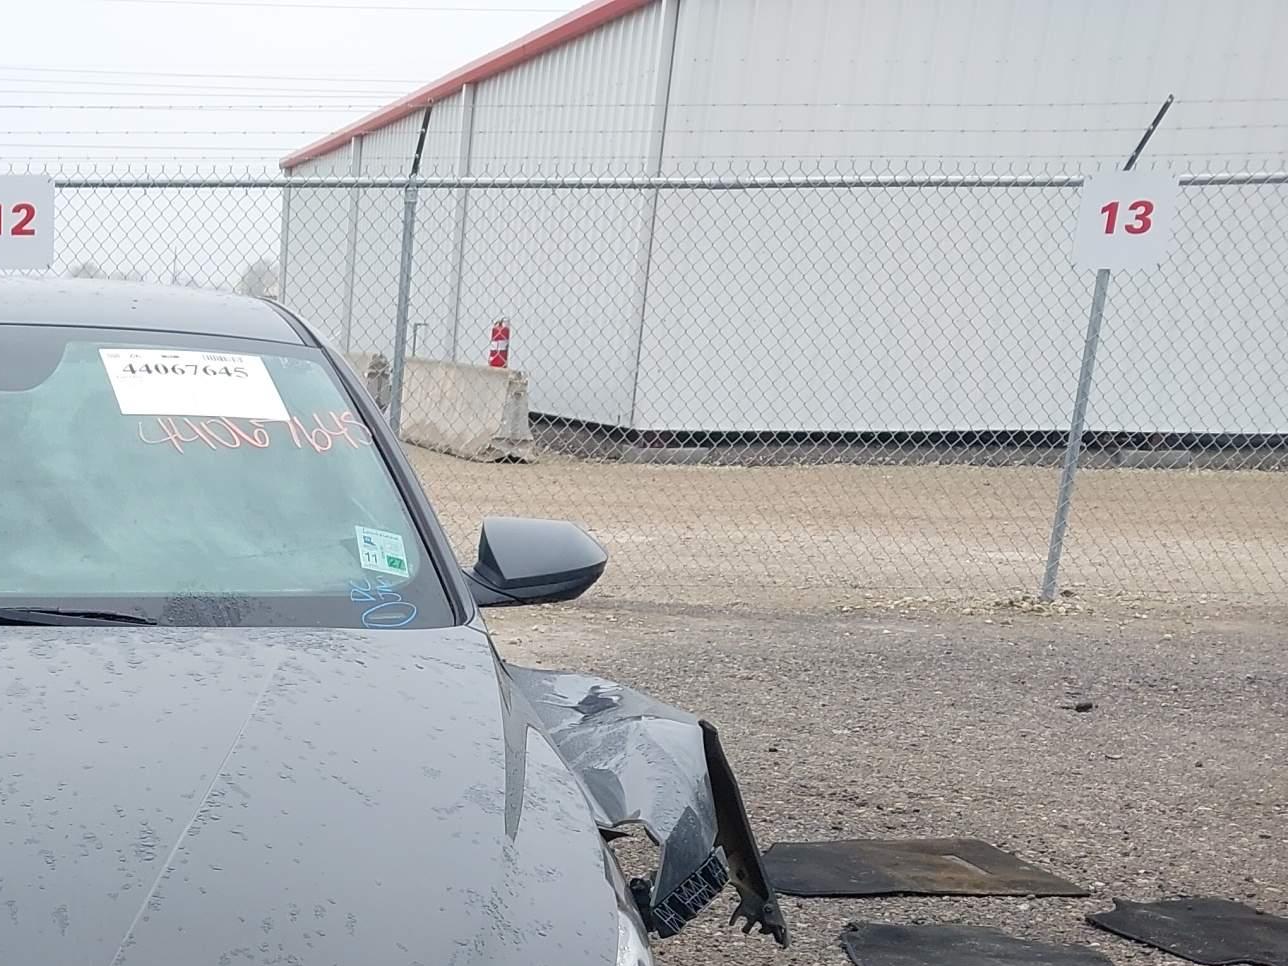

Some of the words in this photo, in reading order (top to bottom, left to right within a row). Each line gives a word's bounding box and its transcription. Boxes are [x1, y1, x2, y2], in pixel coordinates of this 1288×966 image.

[1099, 200, 1155, 235] 13
[121, 362, 250, 380] 44067645
[364, 551, 378, 565] 11
